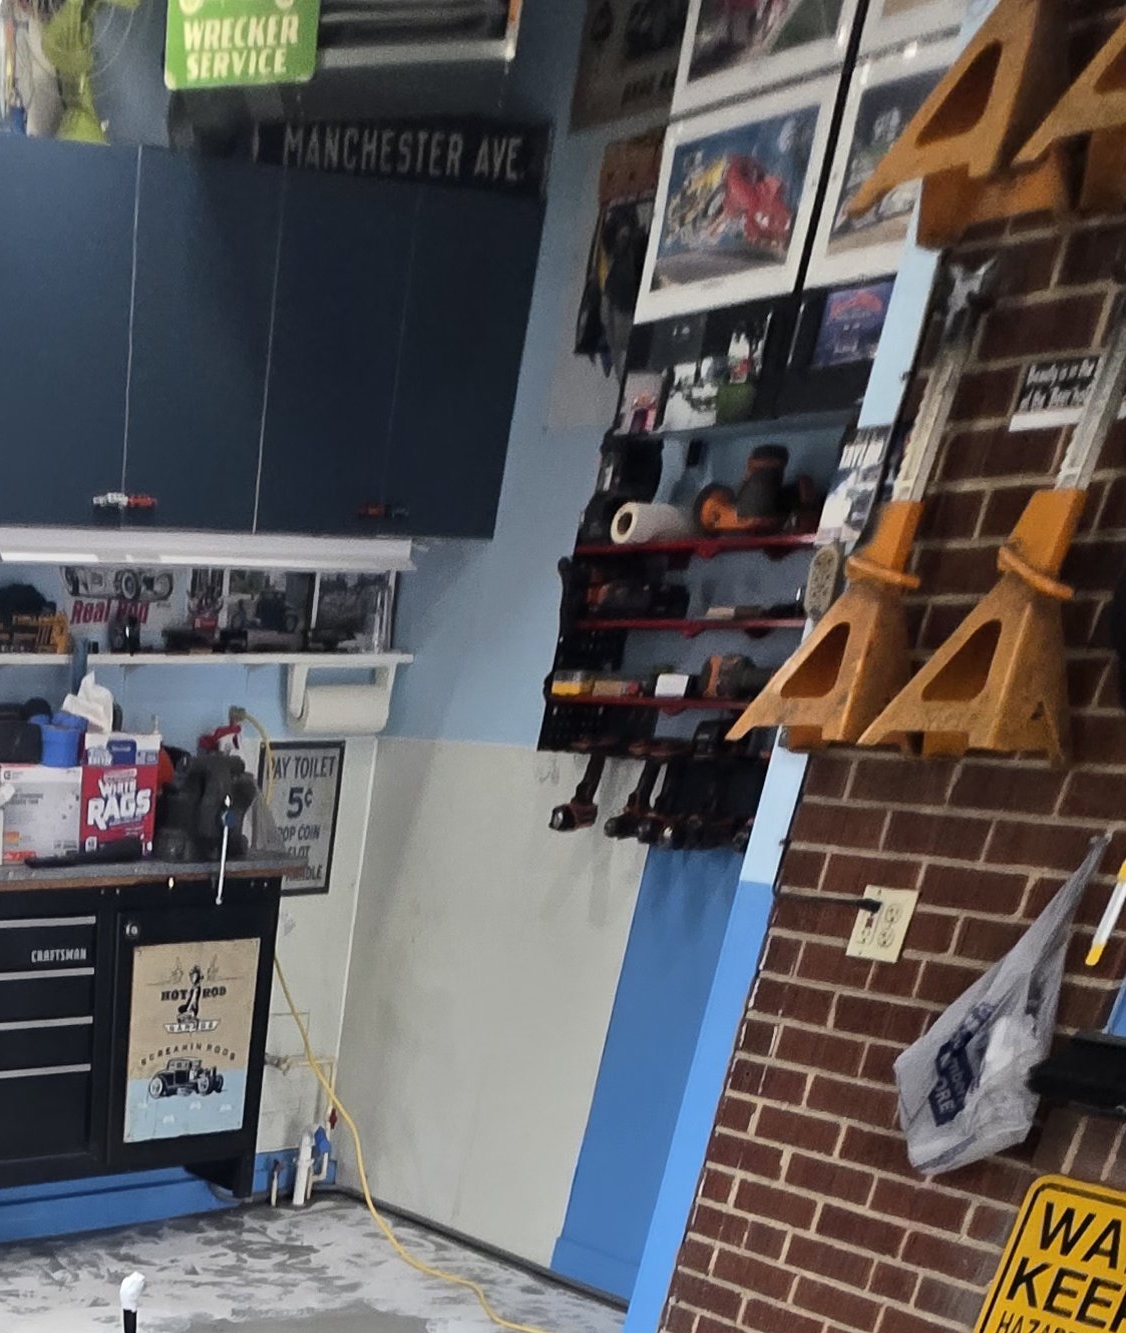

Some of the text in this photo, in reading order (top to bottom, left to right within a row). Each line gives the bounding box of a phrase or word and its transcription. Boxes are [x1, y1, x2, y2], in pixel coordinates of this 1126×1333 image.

[183, 14, 299, 51] WRECKER
[186, 48, 288, 81] SERVICE
[282, 120, 465, 178] MANCHESTER
[294, 756, 336, 780] TOILET
[87, 789, 152, 831] RAGS
[298, 824, 321, 841] COIN
[31, 948, 87, 963] CRAFTSMAN
[161, 983, 227, 1001] HOT ROD
[1039, 1200, 1126, 1271] WA
